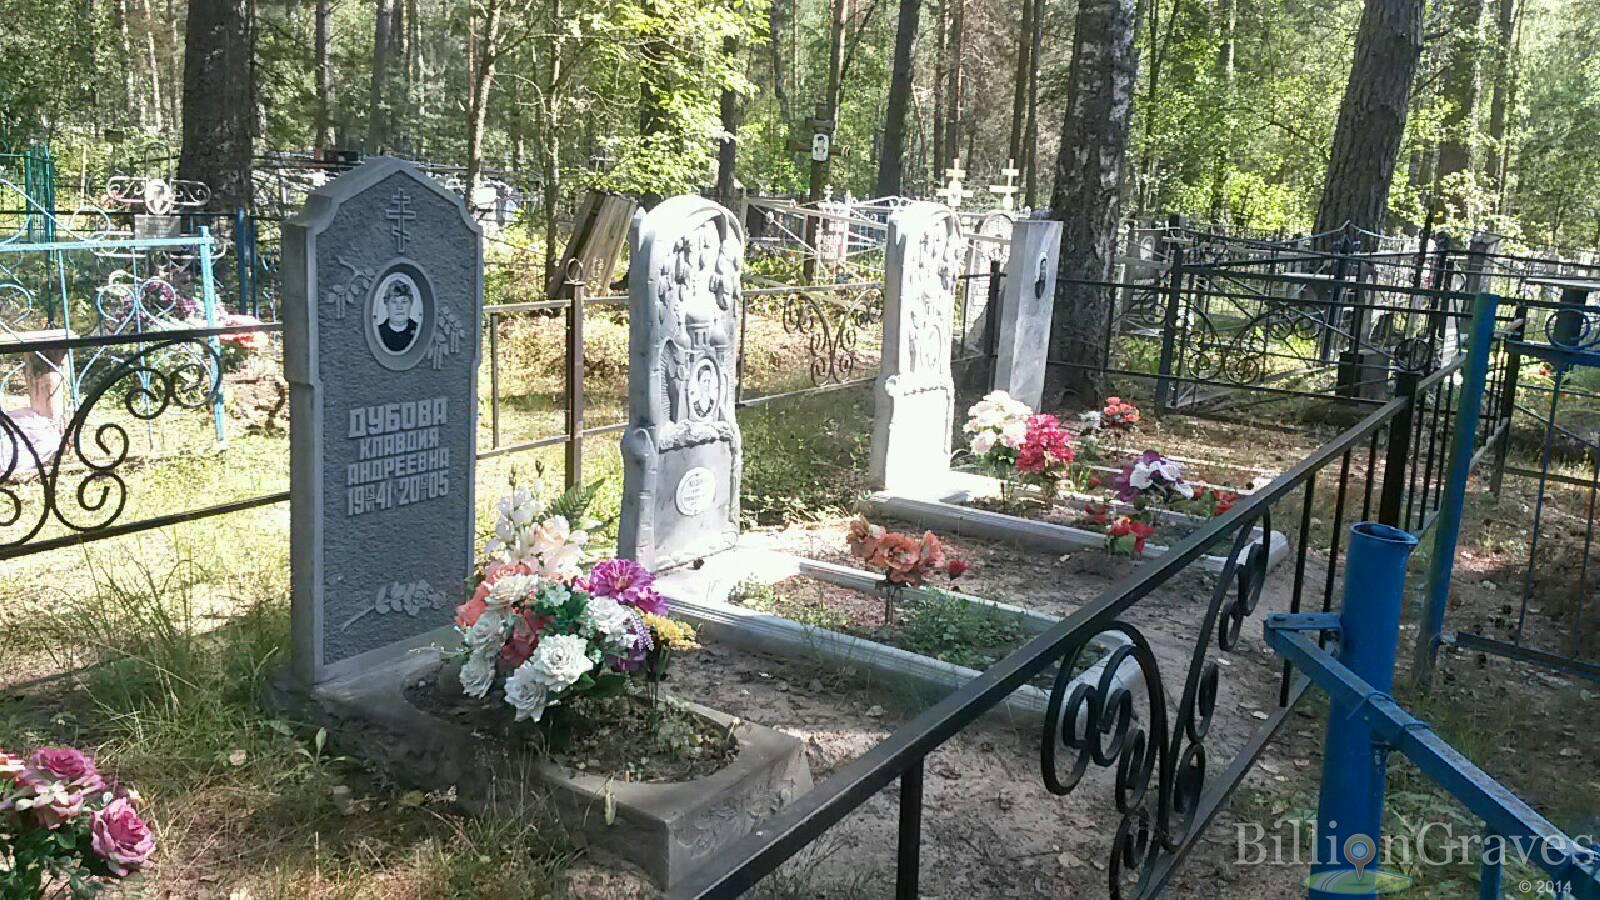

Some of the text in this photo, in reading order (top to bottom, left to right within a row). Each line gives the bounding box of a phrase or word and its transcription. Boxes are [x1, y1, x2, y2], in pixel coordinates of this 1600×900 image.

[348, 396, 448, 438] ДУБОВА
[360, 427, 440, 460] КЛАВДИЯ
[347, 447, 450, 486] АНДРЕЕВНА
